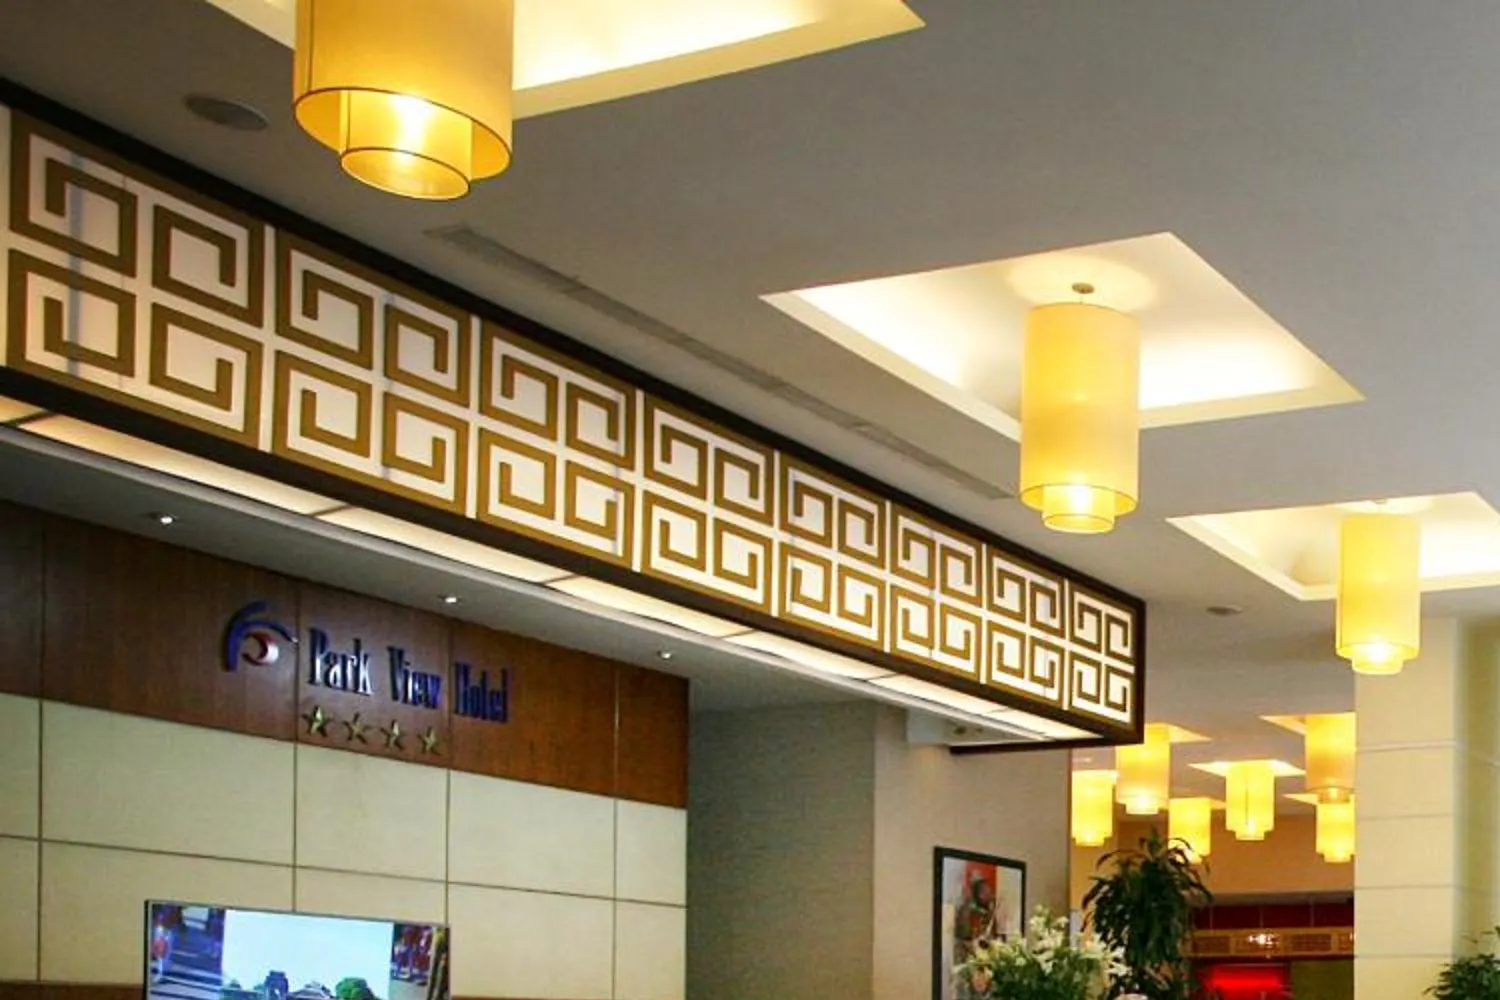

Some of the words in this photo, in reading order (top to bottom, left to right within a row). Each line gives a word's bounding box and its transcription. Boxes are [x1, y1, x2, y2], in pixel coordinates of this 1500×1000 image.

[309, 627, 373, 696] Park
[387, 646, 442, 709] View
[454, 661, 509, 723] Hotel
